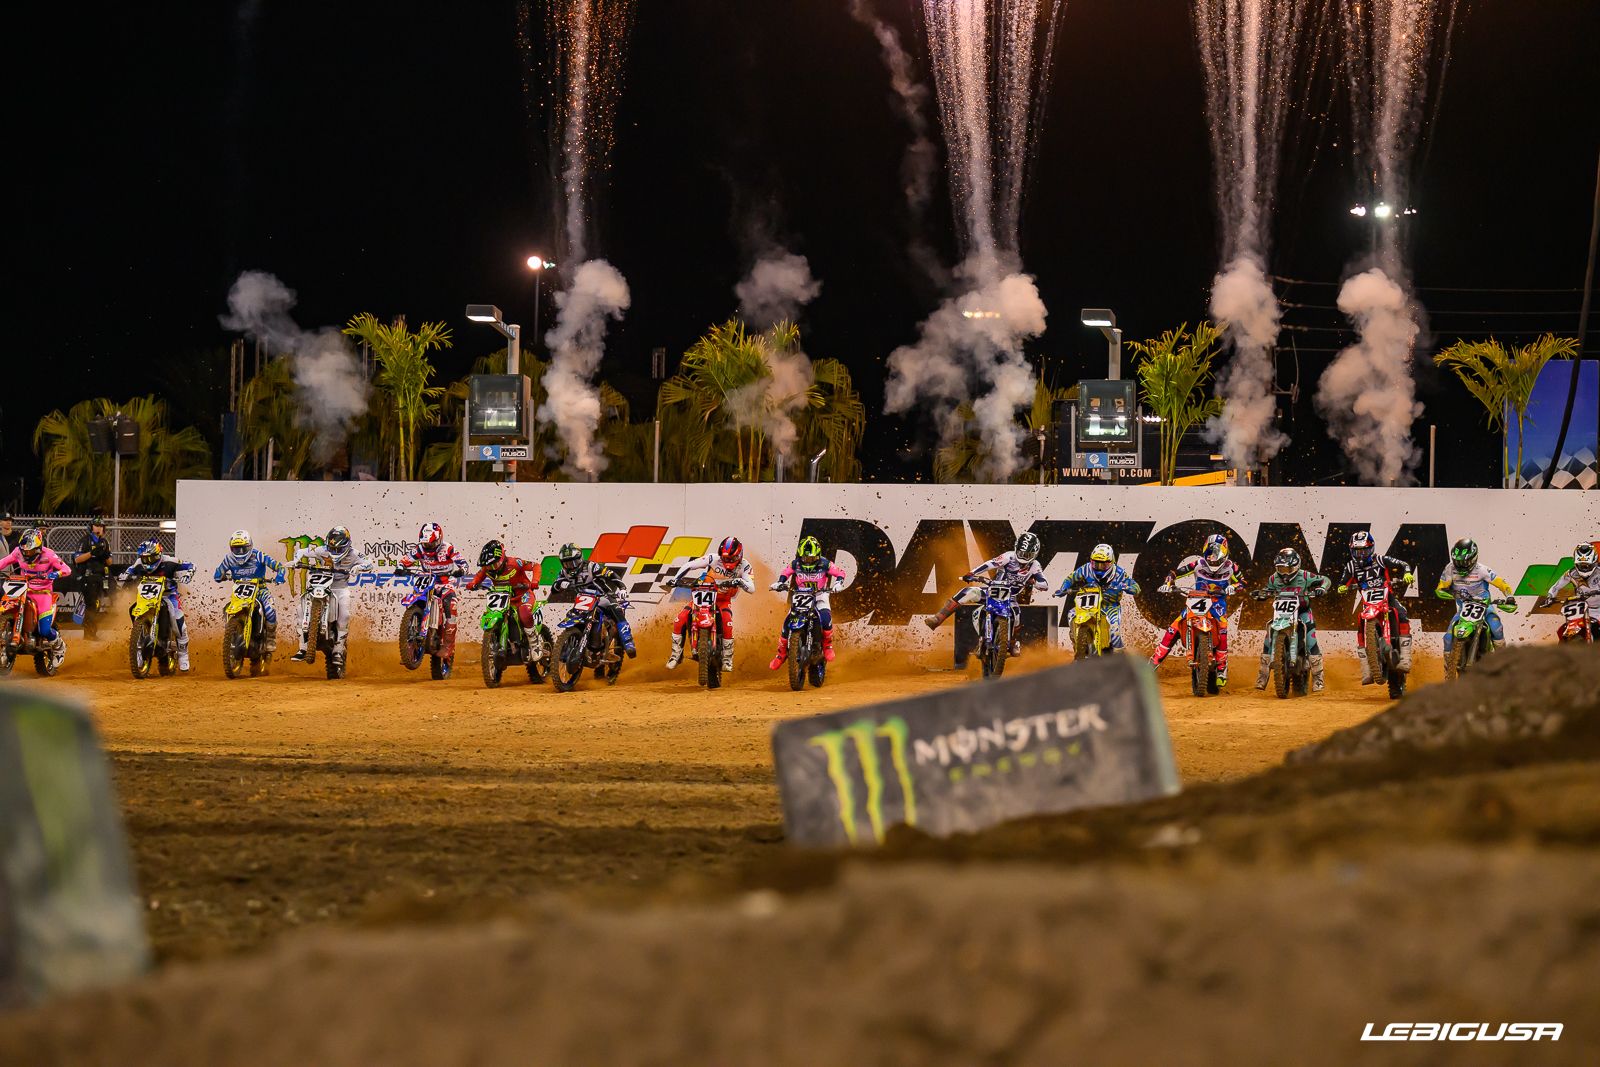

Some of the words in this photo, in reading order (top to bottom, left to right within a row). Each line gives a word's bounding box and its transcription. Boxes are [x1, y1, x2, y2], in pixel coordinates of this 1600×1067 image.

[1062, 467, 1152, 478] WWW.MO.COM
[308, 574, 332, 585] 27
[786, 518, 1458, 632] DAYTONA
[1357, 566, 1381, 581] FLY
[7, 582, 25, 596] 7
[414, 574, 430, 590] 49
[140, 584, 159, 596] 94
[234, 584, 254, 596] 45
[989, 587, 1010, 600] 37
[1366, 591, 1385, 603] 12
[488, 594, 509, 609] 21
[575, 595, 594, 611] 2
[694, 591, 713, 606] 14
[793, 594, 815, 608] 32
[1081, 594, 1096, 607] 11
[1191, 598, 1207, 613] 4
[1274, 600, 1298, 613] 146
[1461, 604, 1484, 620] 33
[1563, 602, 1585, 618] 51
[913, 703, 1108, 767] MONSTER
